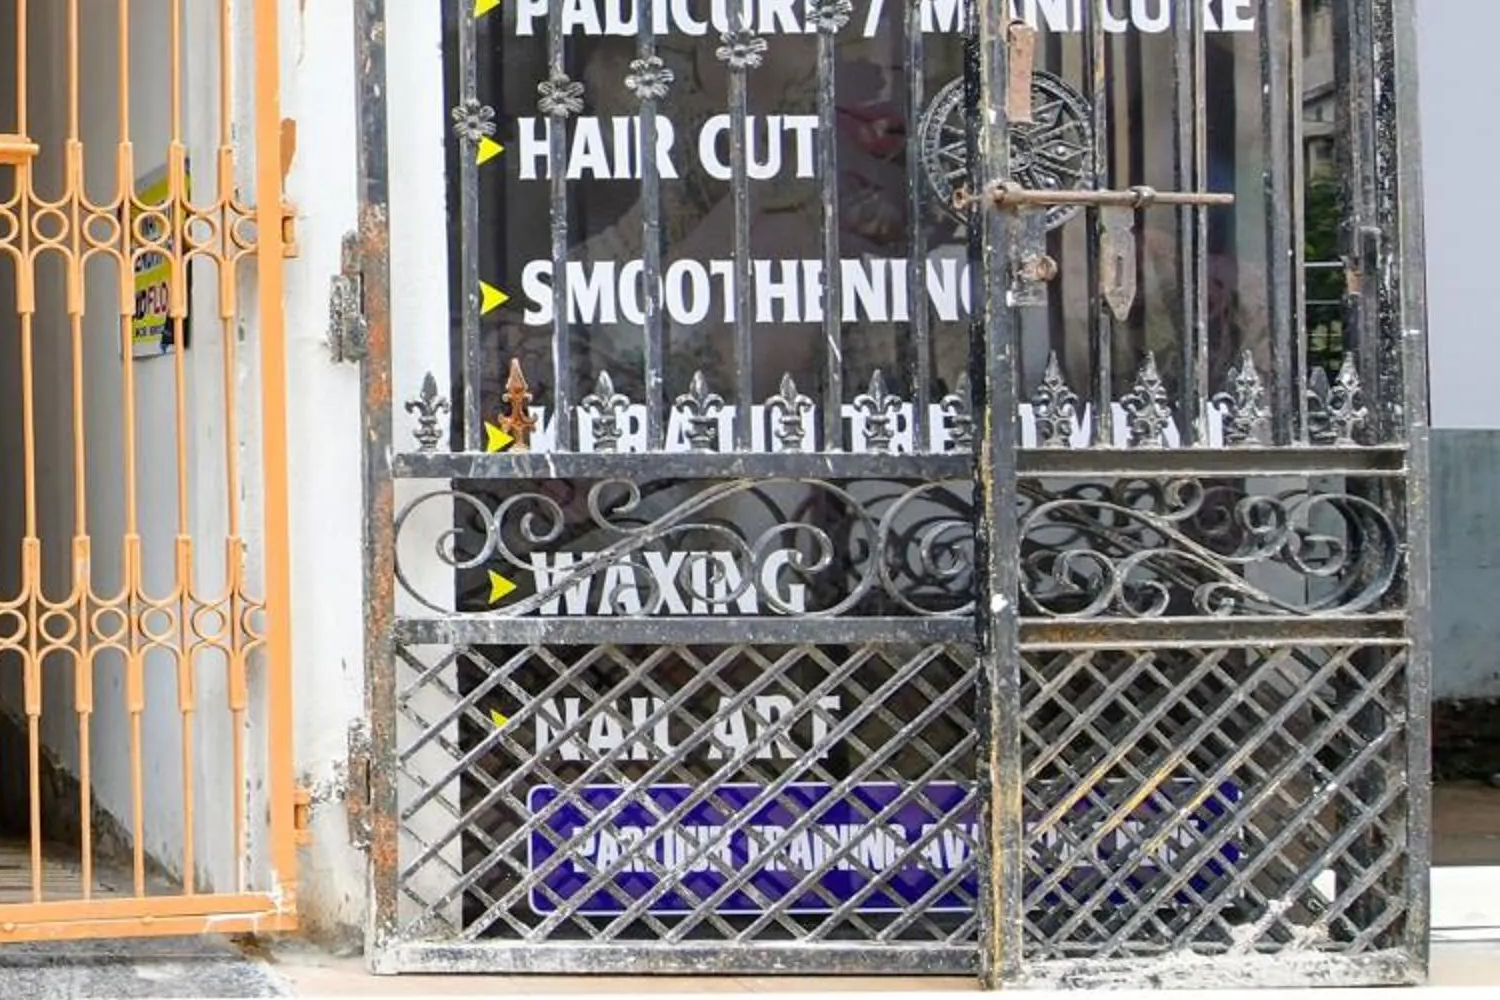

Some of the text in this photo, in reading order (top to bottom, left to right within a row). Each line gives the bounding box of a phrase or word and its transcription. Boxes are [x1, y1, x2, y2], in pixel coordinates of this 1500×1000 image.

[517, 114, 820, 180] HAIR CUT
[521, 259, 974, 326] SMOOTHENIN
[530, 550, 806, 616] WAXING
[534, 695, 841, 761] NAIL ART
